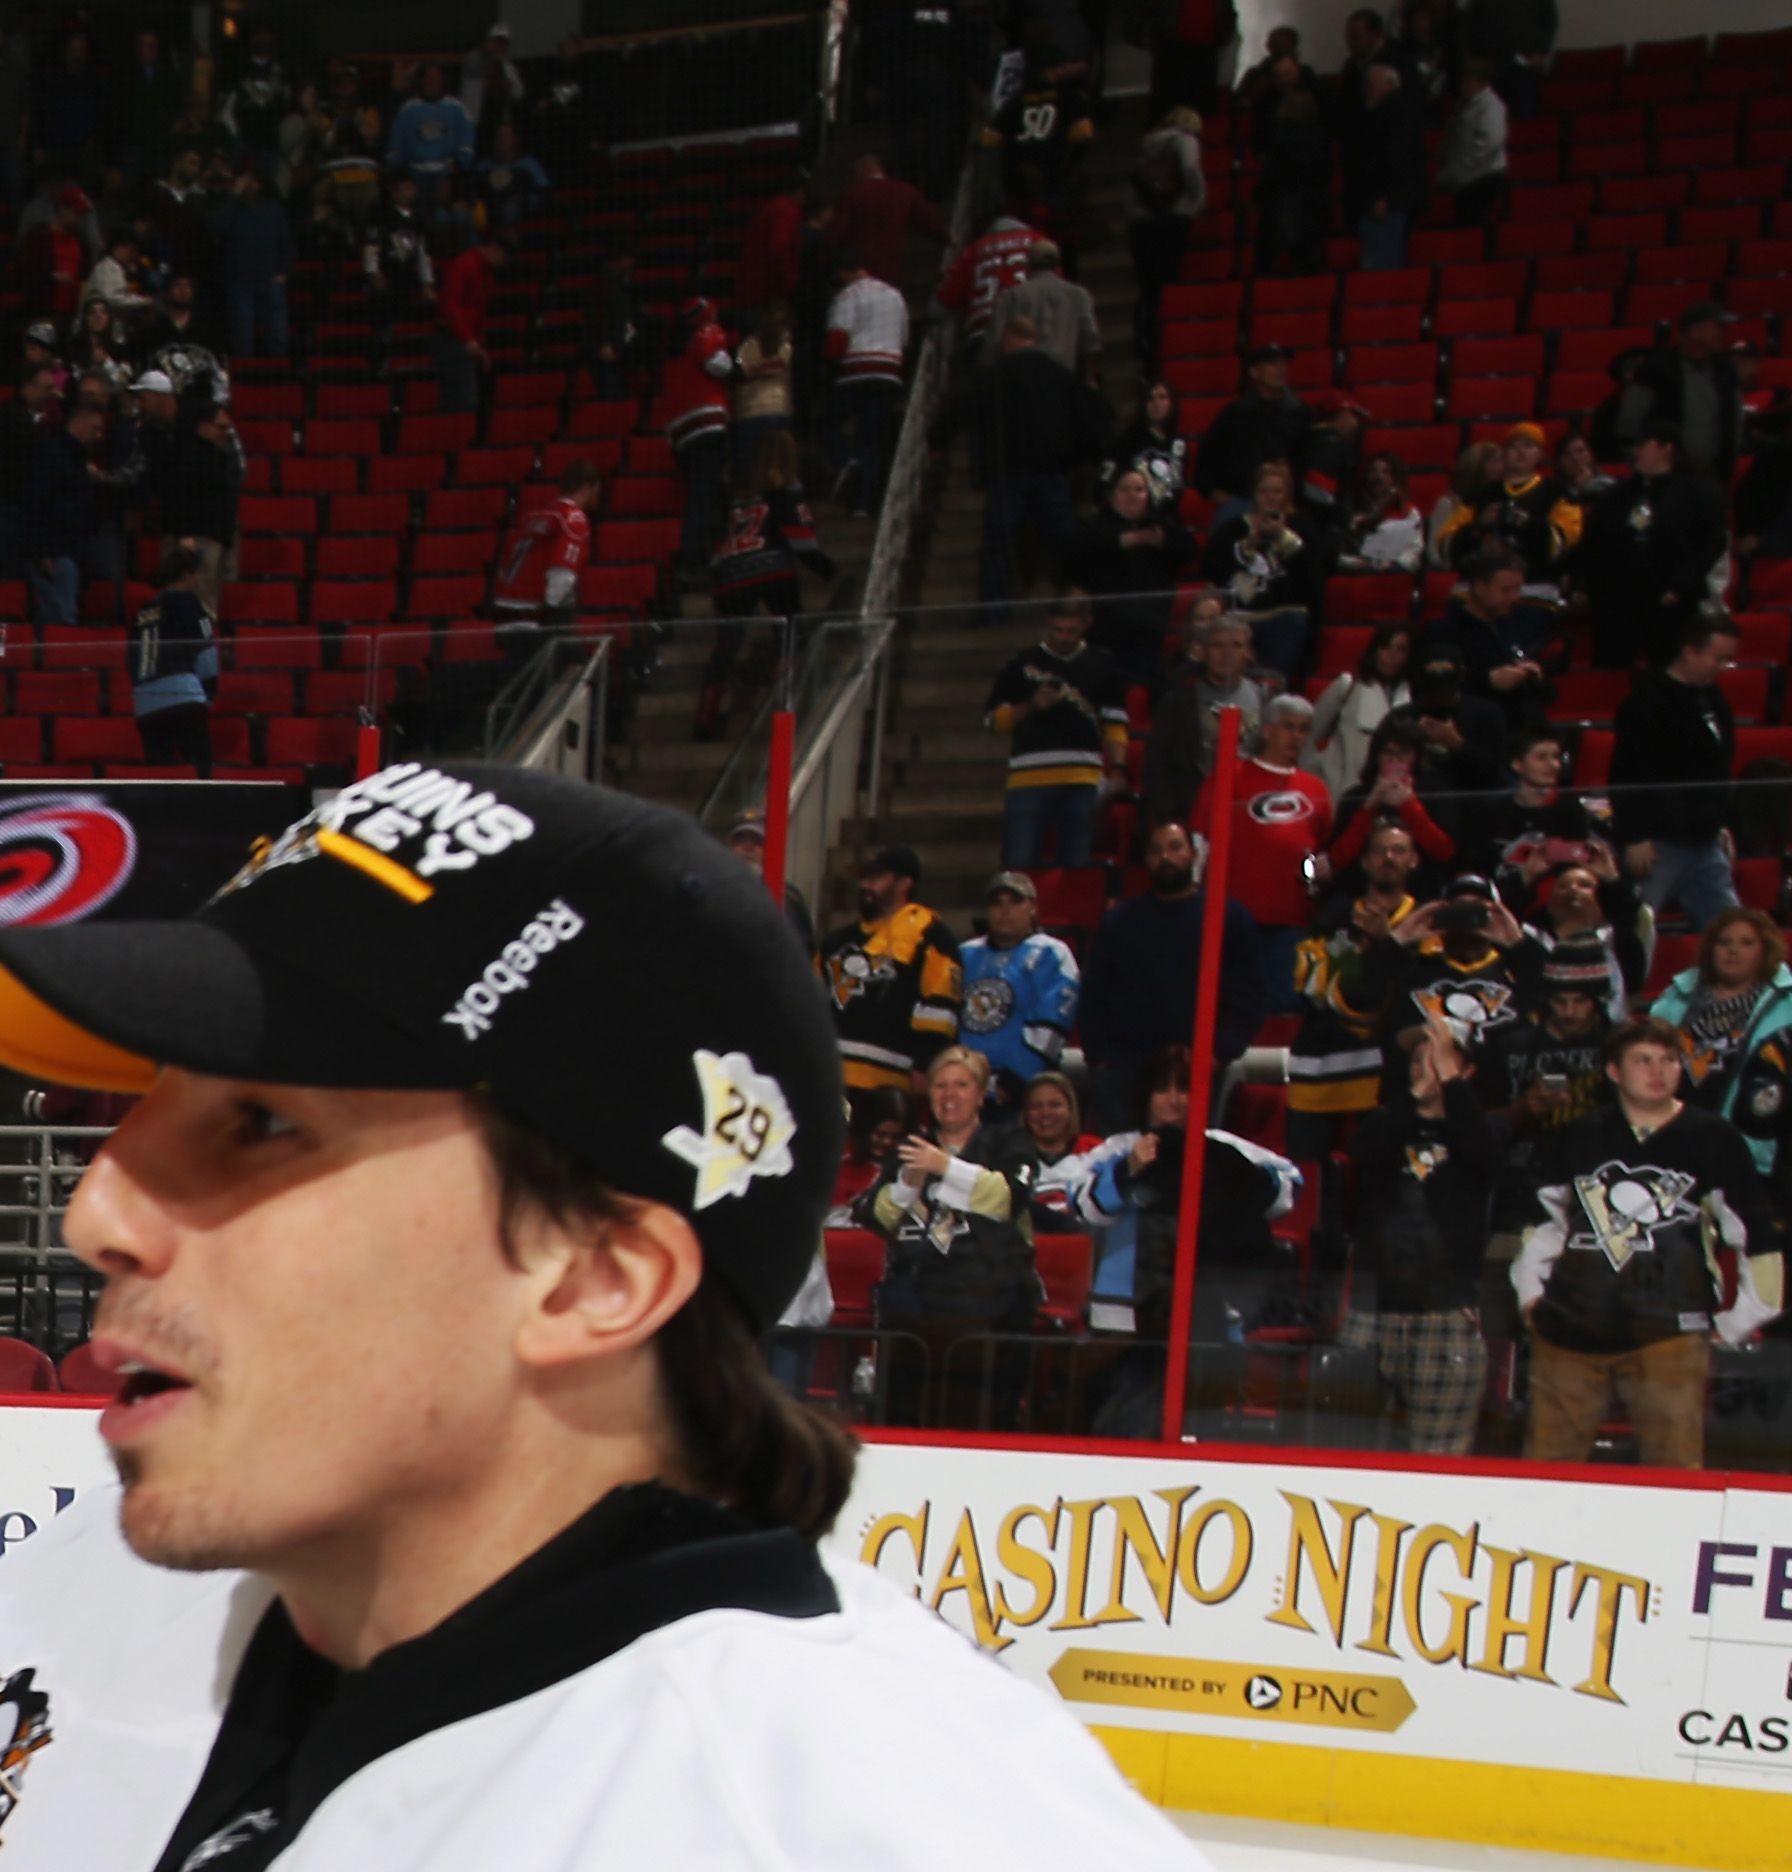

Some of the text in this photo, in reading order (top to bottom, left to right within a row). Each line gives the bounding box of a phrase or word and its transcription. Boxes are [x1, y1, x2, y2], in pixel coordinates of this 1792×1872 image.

[441, 897, 585, 1042] Reebok
[714, 1085, 771, 1162] 29
[858, 1484, 1650, 1707] CASINO NIGHT
[1082, 1667, 1379, 1719] PRESENTED BY PNC
